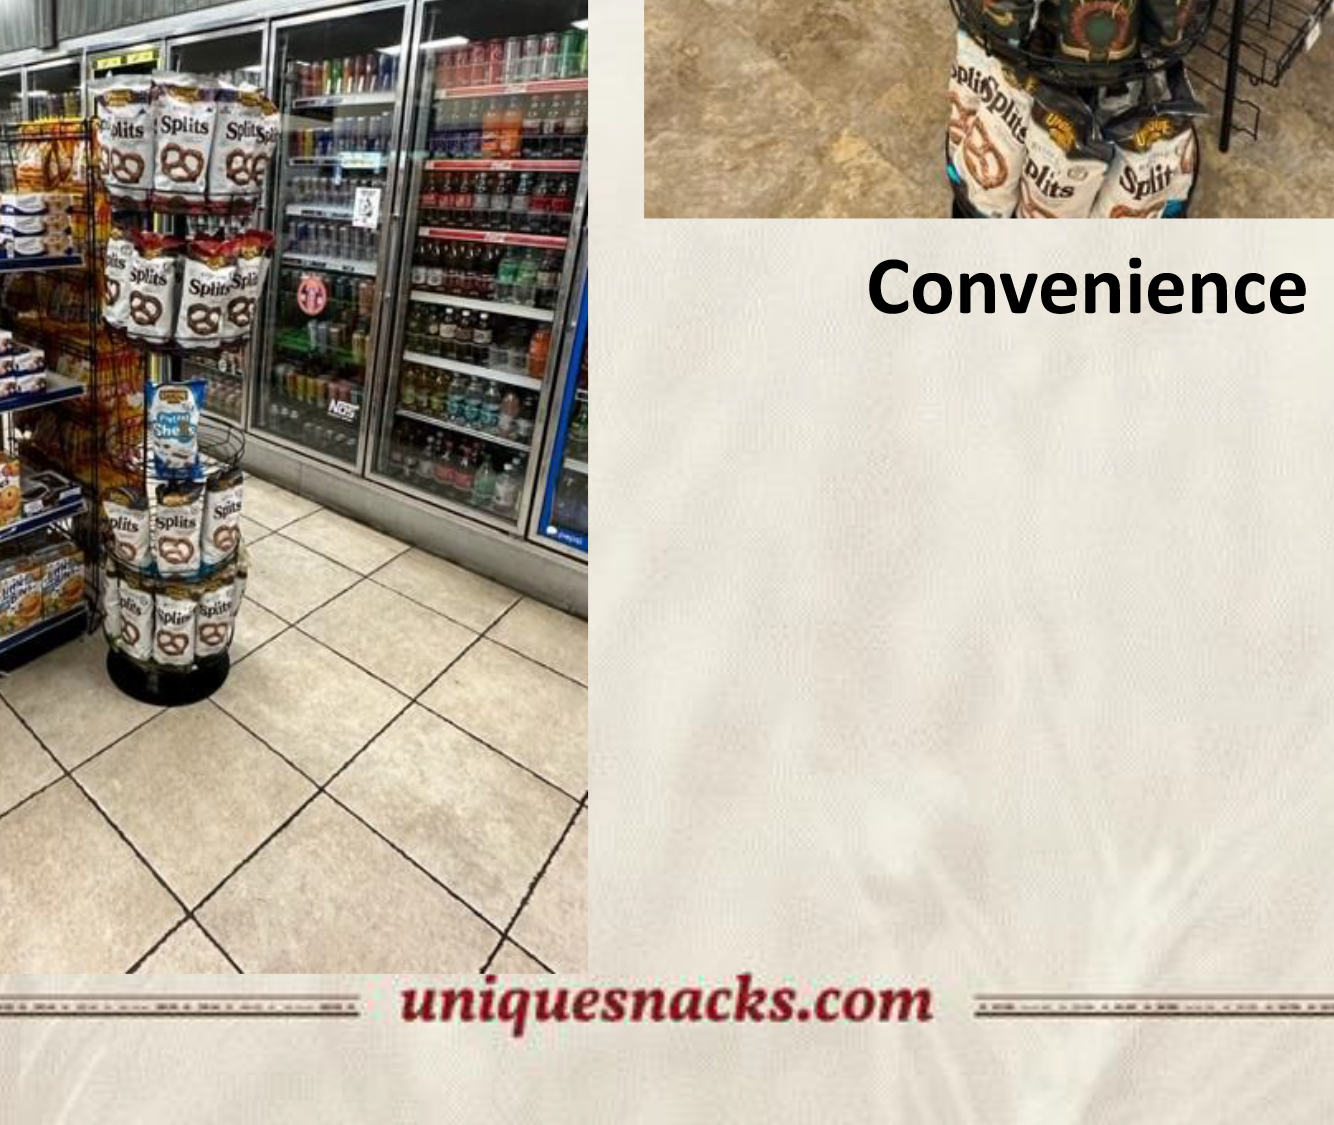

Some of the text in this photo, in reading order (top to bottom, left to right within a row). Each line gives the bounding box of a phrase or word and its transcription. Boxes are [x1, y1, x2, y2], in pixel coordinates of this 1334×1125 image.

[160, 115, 210, 136] Splits
[1118, 165, 1175, 201] Split
[129, 267, 168, 287] Splits
[188, 277, 233, 299] Splits
[155, 515, 197, 533] Splits
